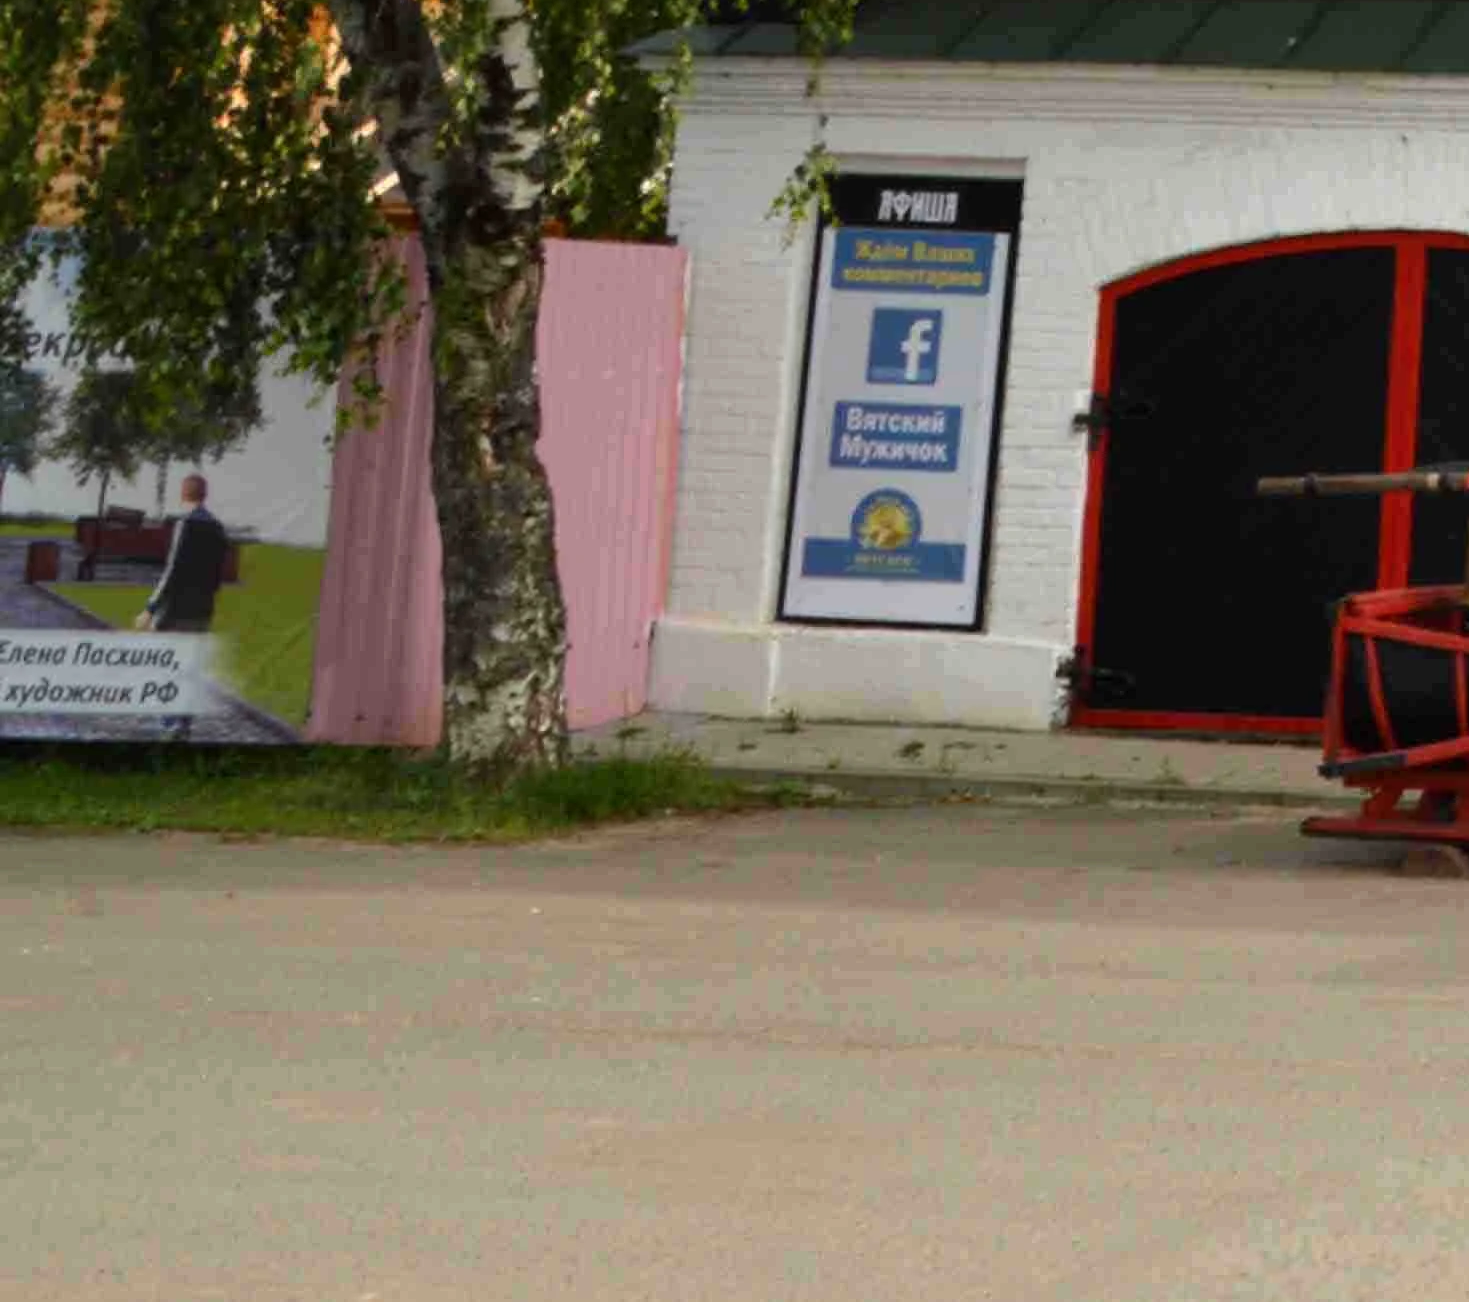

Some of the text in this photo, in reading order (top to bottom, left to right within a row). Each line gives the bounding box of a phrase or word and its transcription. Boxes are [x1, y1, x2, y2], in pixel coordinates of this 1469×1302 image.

[877, 189, 960, 224] АФИША
[846, 407, 946, 433] Вятский
[840, 434, 948, 465] Мужичок
[141, 679, 180, 705] РФ
